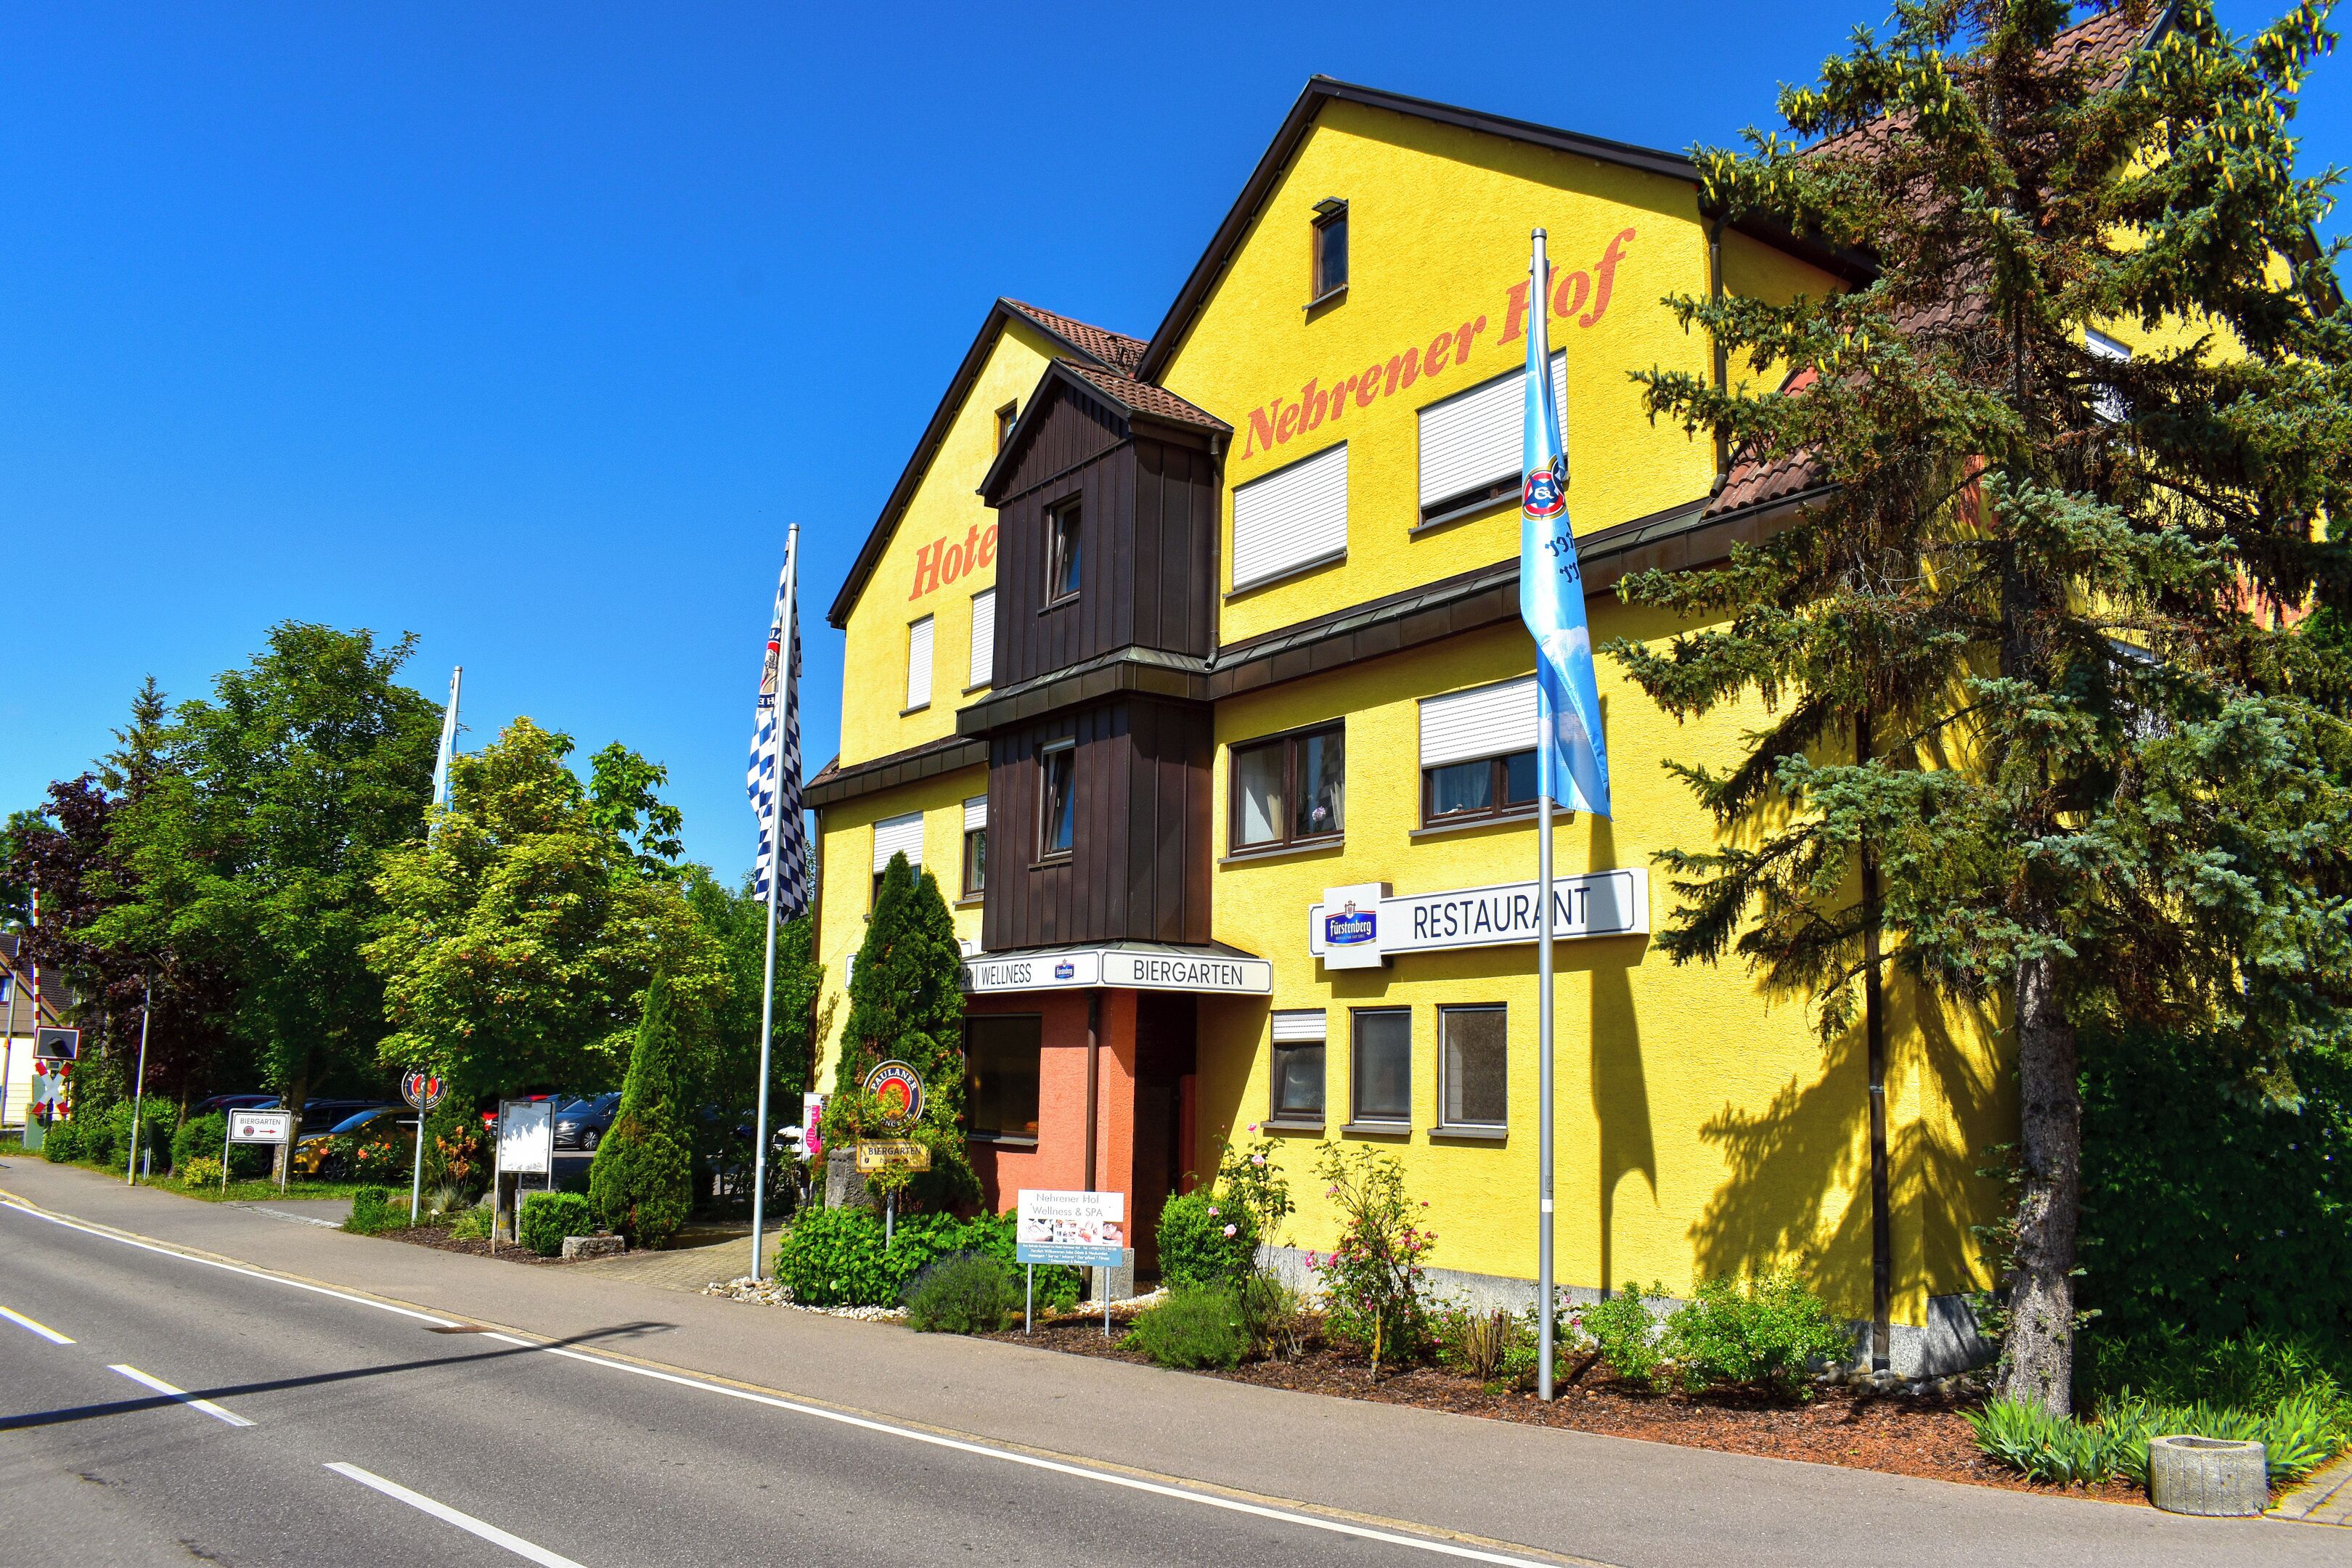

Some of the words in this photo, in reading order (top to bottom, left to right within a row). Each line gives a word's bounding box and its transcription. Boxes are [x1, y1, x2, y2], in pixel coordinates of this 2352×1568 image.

[1241, 314, 1487, 461] Nehrener
[1497, 227, 1636, 346] Hof
[909, 524, 998, 601] Hote
[960, 968, 972, 987] AR
[981, 963, 1032, 986] WELLNESS
[1134, 959, 1243, 986] BIERGARTEN
[870, 1068, 918, 1091] PAULANER
[868, 1147, 921, 1156] BIERGARTEN
[1037, 1193, 1079, 1203] Nehrener
[1082, 1194, 1100, 1204] Hof
[1032, 1206, 1072, 1216] Wellness
[1075, 1207, 1082, 1216] &
[1085, 1208, 1103, 1217] SPA
